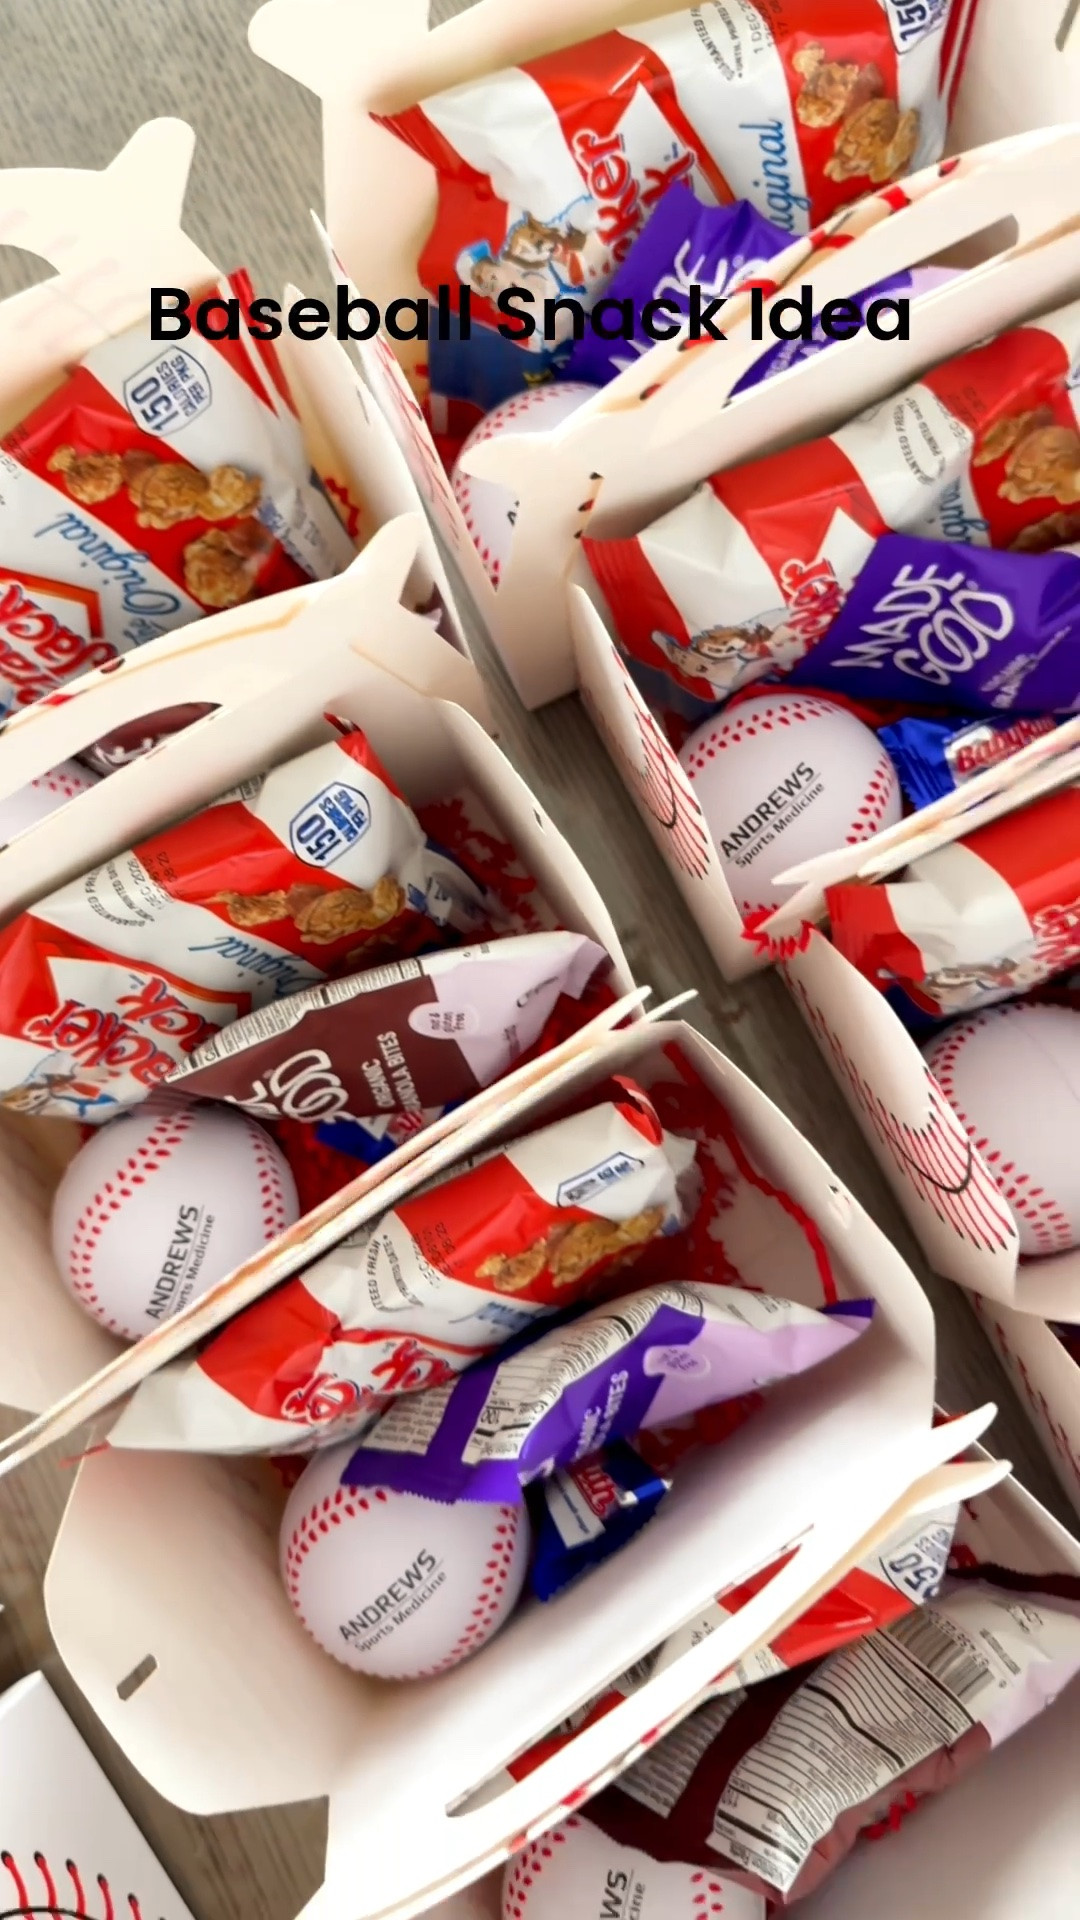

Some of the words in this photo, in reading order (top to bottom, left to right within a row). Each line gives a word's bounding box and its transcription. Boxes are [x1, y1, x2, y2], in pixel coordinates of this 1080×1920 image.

[892, 0, 928, 43] 15
[131, 376, 179, 431] 150
[156, 360, 198, 417] CALORIES
[33, 512, 182, 616] Original
[830, 563, 965, 669] MADE
[893, 588, 1015, 686] GOOD
[296, 813, 341, 862] 150
[718, 761, 815, 859] ANDREWS
[734, 834, 775, 869] Sports
[772, 782, 826, 842] Medicine
[21, 998, 178, 1086] acker
[115, 975, 222, 1052] ack
[376, 1030, 403, 1068] BITES
[144, 1204, 199, 1320] ANDREWS
[173, 1283, 194, 1314] orts
[185, 1214, 216, 1280] Medicine
[366, 1239, 381, 1277] FRESH
[339, 1548, 436, 1641] ANDREWS
[354, 1624, 395, 1652] Sports
[391, 1570, 447, 1626] Medicine
[600, 1868, 628, 1920] WS
